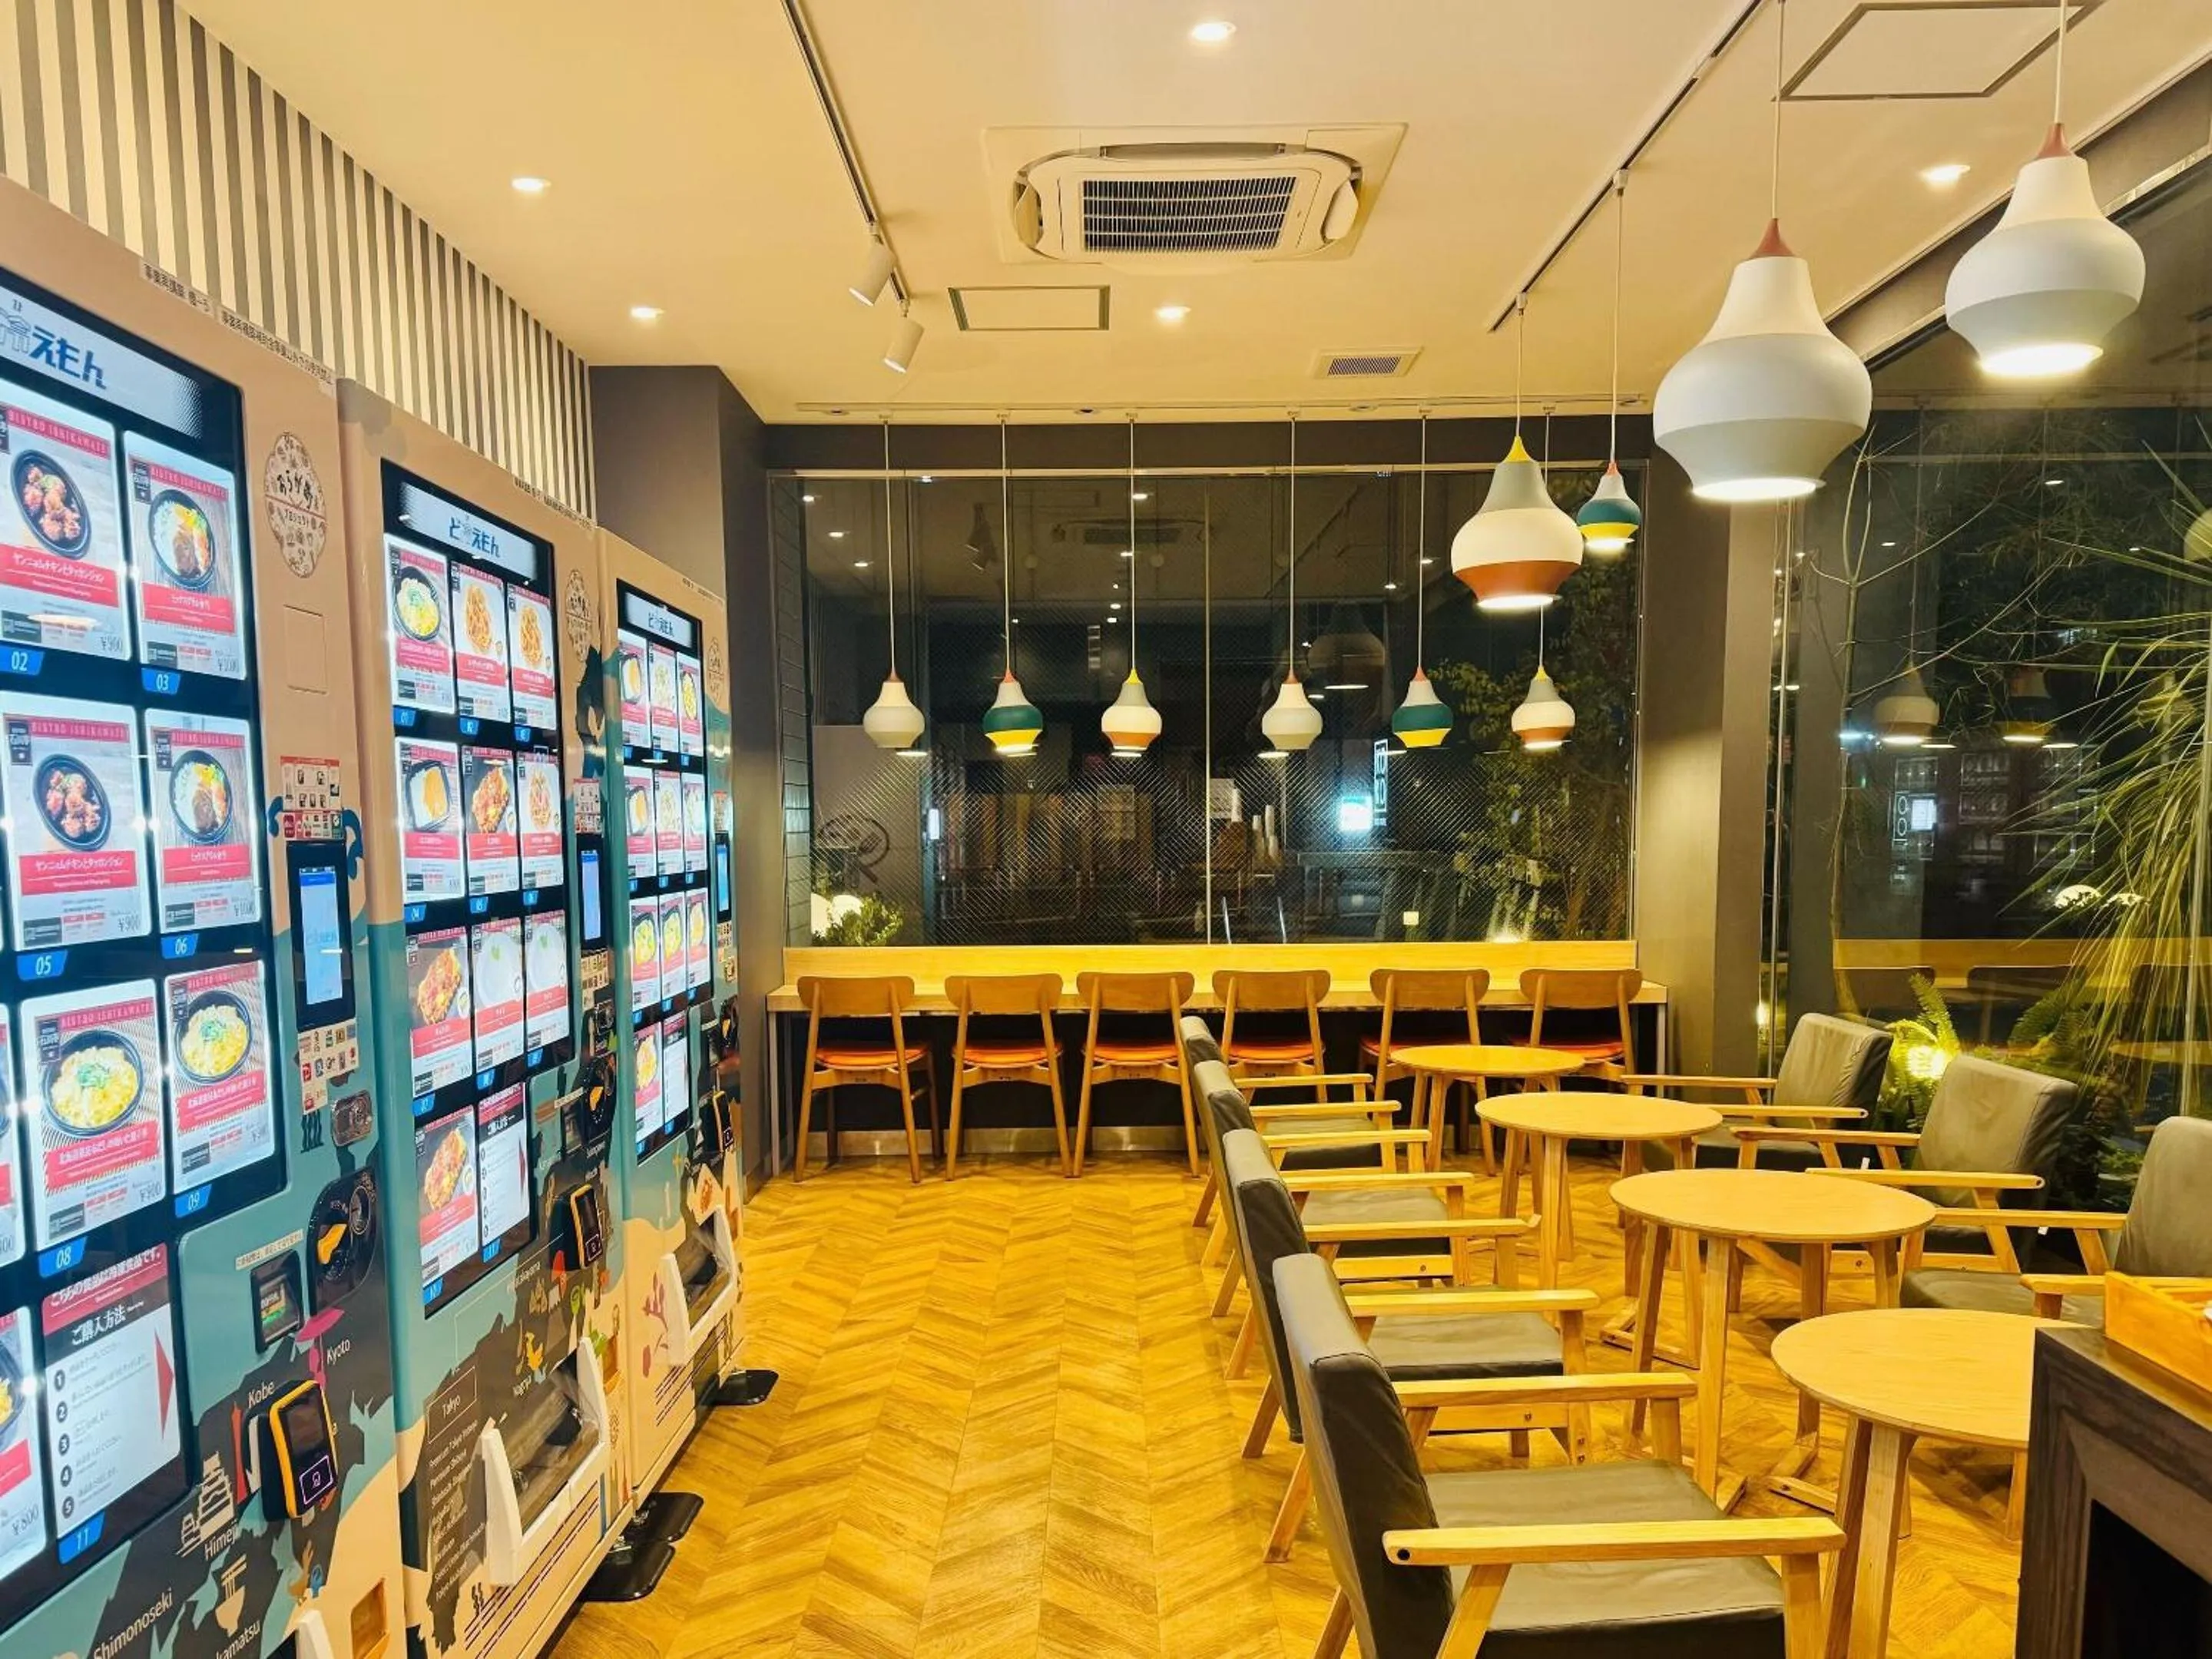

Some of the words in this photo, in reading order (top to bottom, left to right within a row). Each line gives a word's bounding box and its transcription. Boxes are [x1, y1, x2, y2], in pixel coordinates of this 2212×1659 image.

[11, 651, 28, 671] 02
[156, 674, 169, 690] 03
[174, 937, 189, 954] 06
[35, 955, 52, 975] 05
[56, 1246, 72, 1269] 08
[326, 1339, 351, 1366] Kyoto
[248, 1381, 276, 1409] Kobe
[77, 1527, 90, 1549] 11
[204, 1518, 239, 1561] Himeji
[93, 1586, 173, 1659] Shimonoseki
